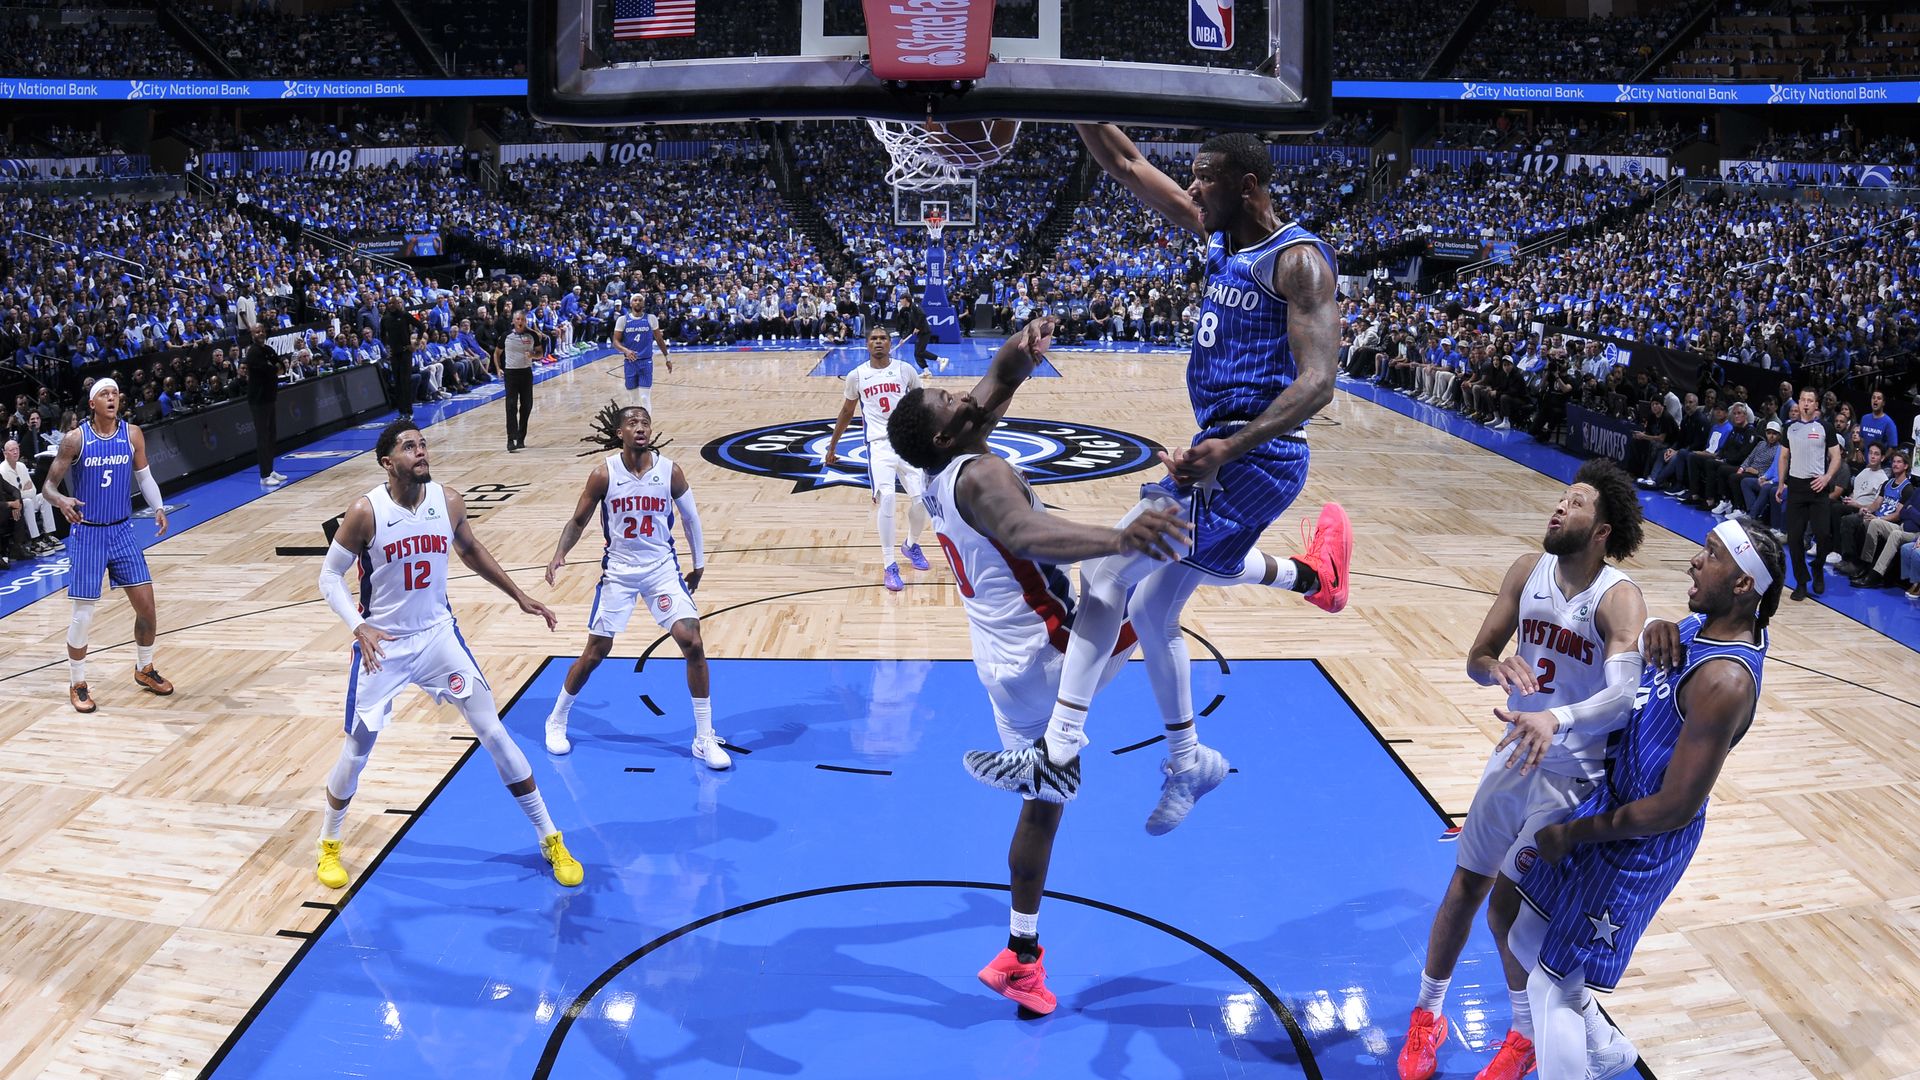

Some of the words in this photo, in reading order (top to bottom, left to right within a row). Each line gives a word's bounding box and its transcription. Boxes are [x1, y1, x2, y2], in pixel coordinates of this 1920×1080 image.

[1196, 26, 1217, 43] NBA
[0, 82, 15, 97] ity
[18, 82, 66, 96] National
[69, 83, 98, 96] Bank
[143, 83, 167, 98] City
[169, 83, 219, 96] National
[221, 83, 250, 96] Bank
[296, 83, 320, 97] City
[323, 83, 373, 95] National
[375, 82, 405, 94] Bank
[1476, 85, 1500, 101] City
[1503, 86, 1552, 98] National
[1555, 87, 1584, 98] Bank
[1631, 87, 1654, 102] City
[1657, 87, 1705, 100] National
[1708, 88, 1738, 100] Bank
[1782, 87, 1806, 103] City
[1809, 87, 1857, 100] National
[1859, 86, 1887, 98] Bank
[310, 149, 352, 172] 108
[1522, 154, 1559, 176] 112
[369, 240, 390, 248] National
[633, 334, 641, 342] 4
[1197, 311, 1219, 348] 8
[863, 382, 901, 399] PISTONS
[879, 396, 890, 413] 9
[1038, 428, 1125, 468] MAGIC
[1590, 424, 1628, 461] PLAYOFFS
[100, 469, 113, 488] 5
[611, 495, 667, 514] PISTONS
[623, 514, 655, 539] 24
[382, 534, 448, 564] PISTONS
[403, 560, 431, 591] 12
[1522, 618, 1596, 666] PISTONS
[1536, 657, 1557, 695] 2
